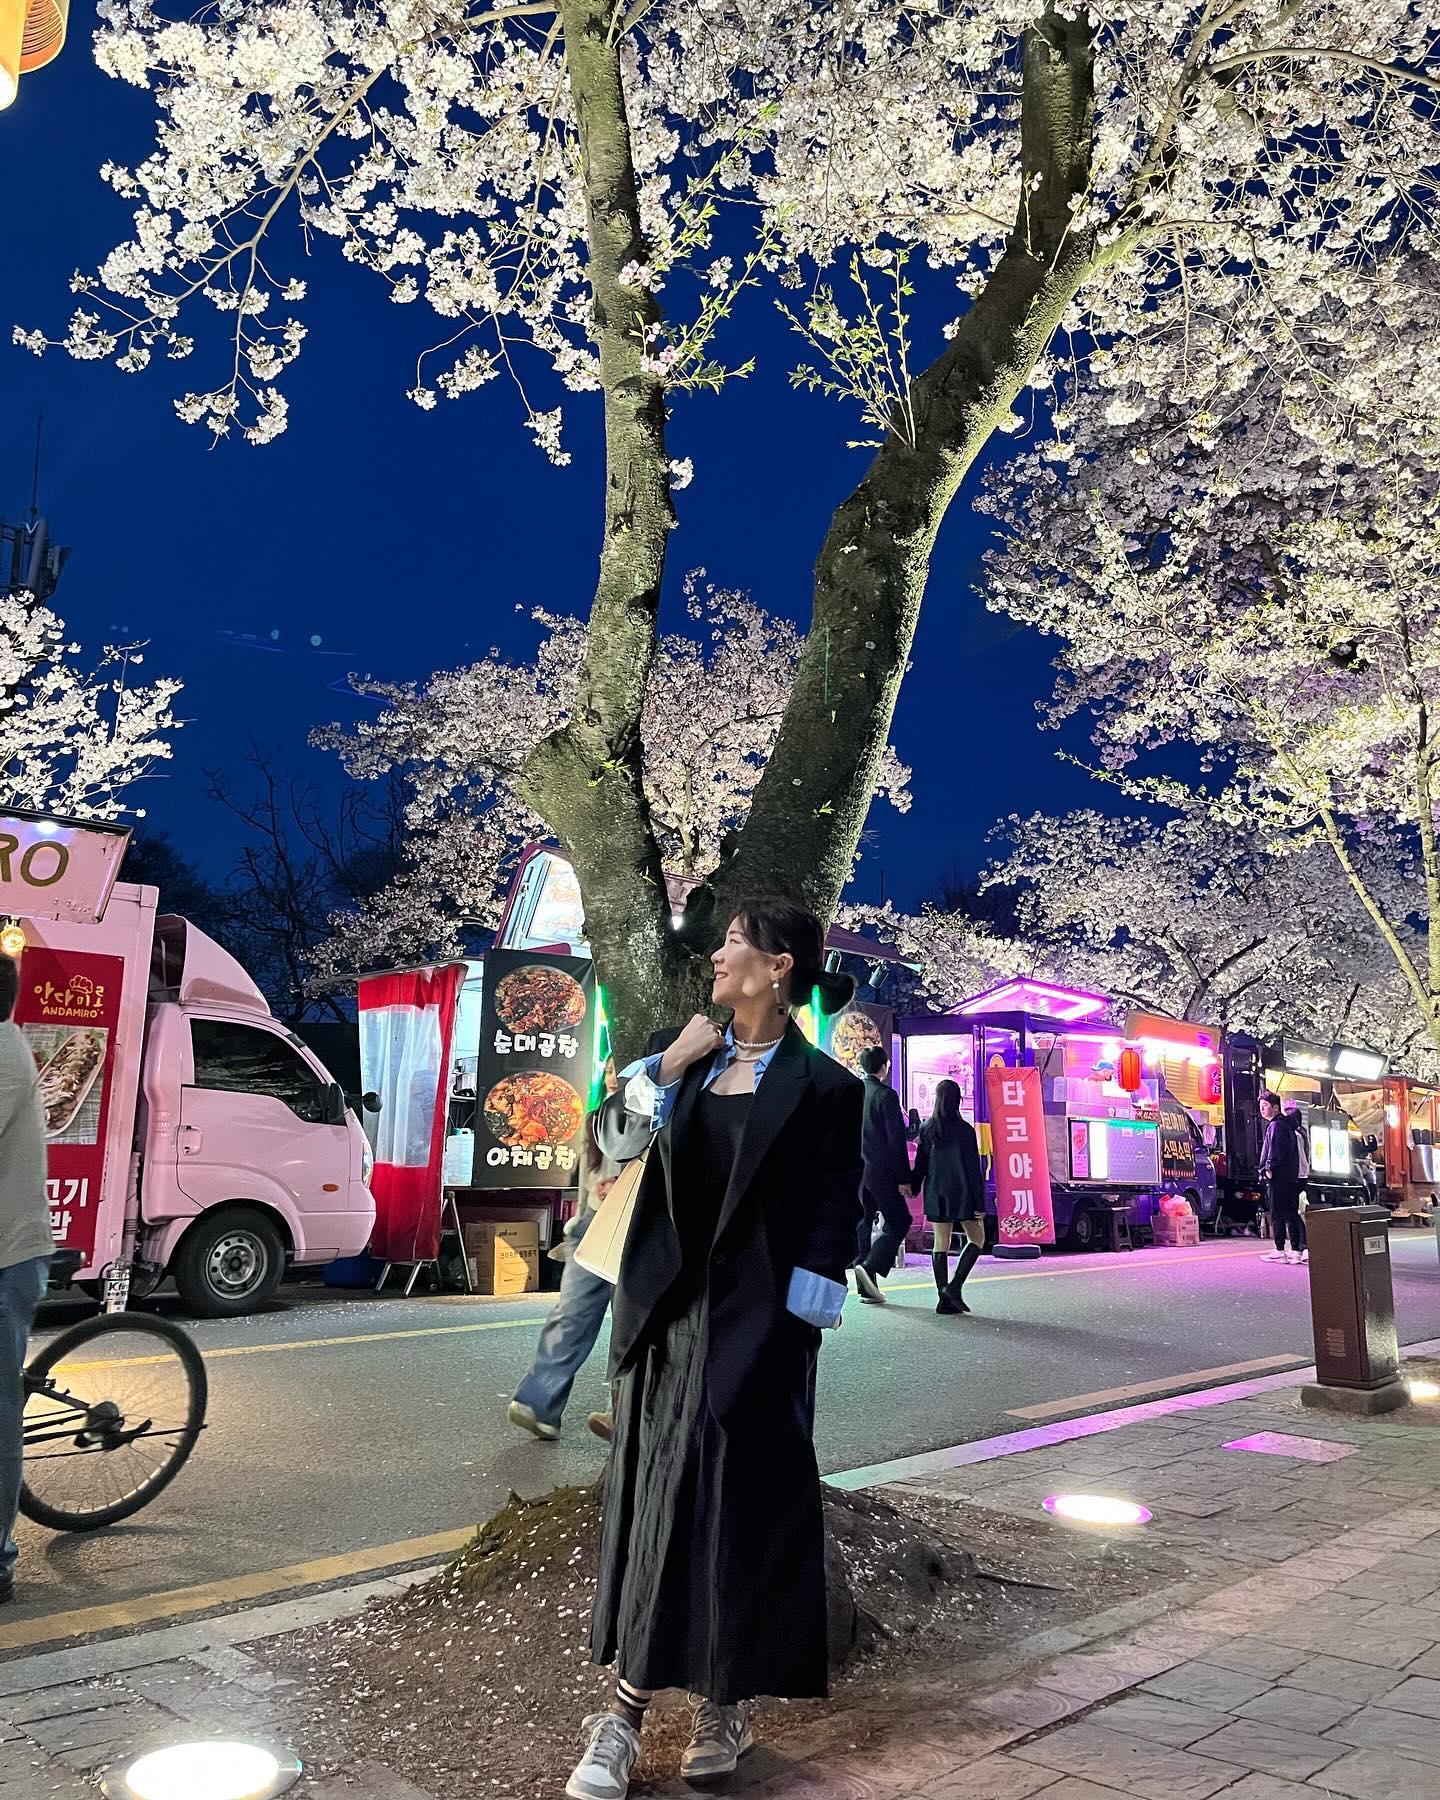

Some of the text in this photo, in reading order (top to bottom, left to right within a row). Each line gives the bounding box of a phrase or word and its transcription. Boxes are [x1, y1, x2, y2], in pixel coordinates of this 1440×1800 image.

[34, 981, 104, 1007] 안다미로
[42, 1006, 98, 1018] ANDAMIRO
[493, 1029, 579, 1059] 순대곱창
[486, 1145, 577, 1171] 야채곱창
[1002, 1080, 1035, 1217] 타코야끼
